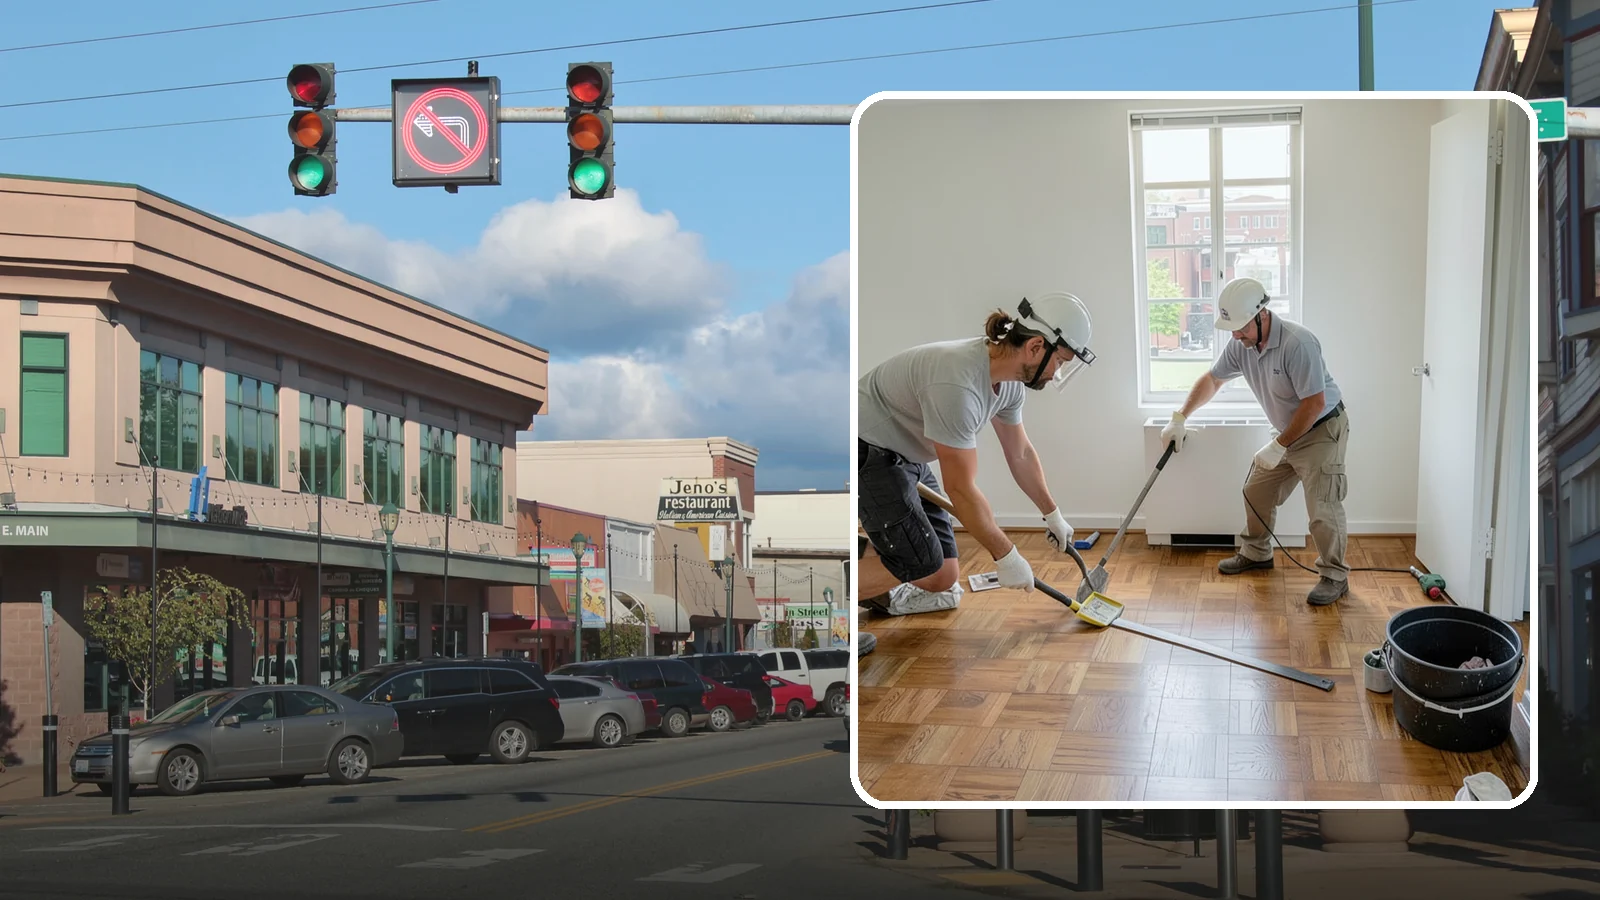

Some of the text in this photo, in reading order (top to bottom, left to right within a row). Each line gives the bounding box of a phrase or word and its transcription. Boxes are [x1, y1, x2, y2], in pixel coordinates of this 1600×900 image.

[669, 480, 728, 495] Jeno's
[665, 496, 731, 509] restaurant
[658, 510, 681, 520] Italian
[686, 509, 714, 519] American
[714, 509, 738, 519] Cuisine
[2, 525, 49, 537] E. MAIN
[797, 607, 828, 616] Street
